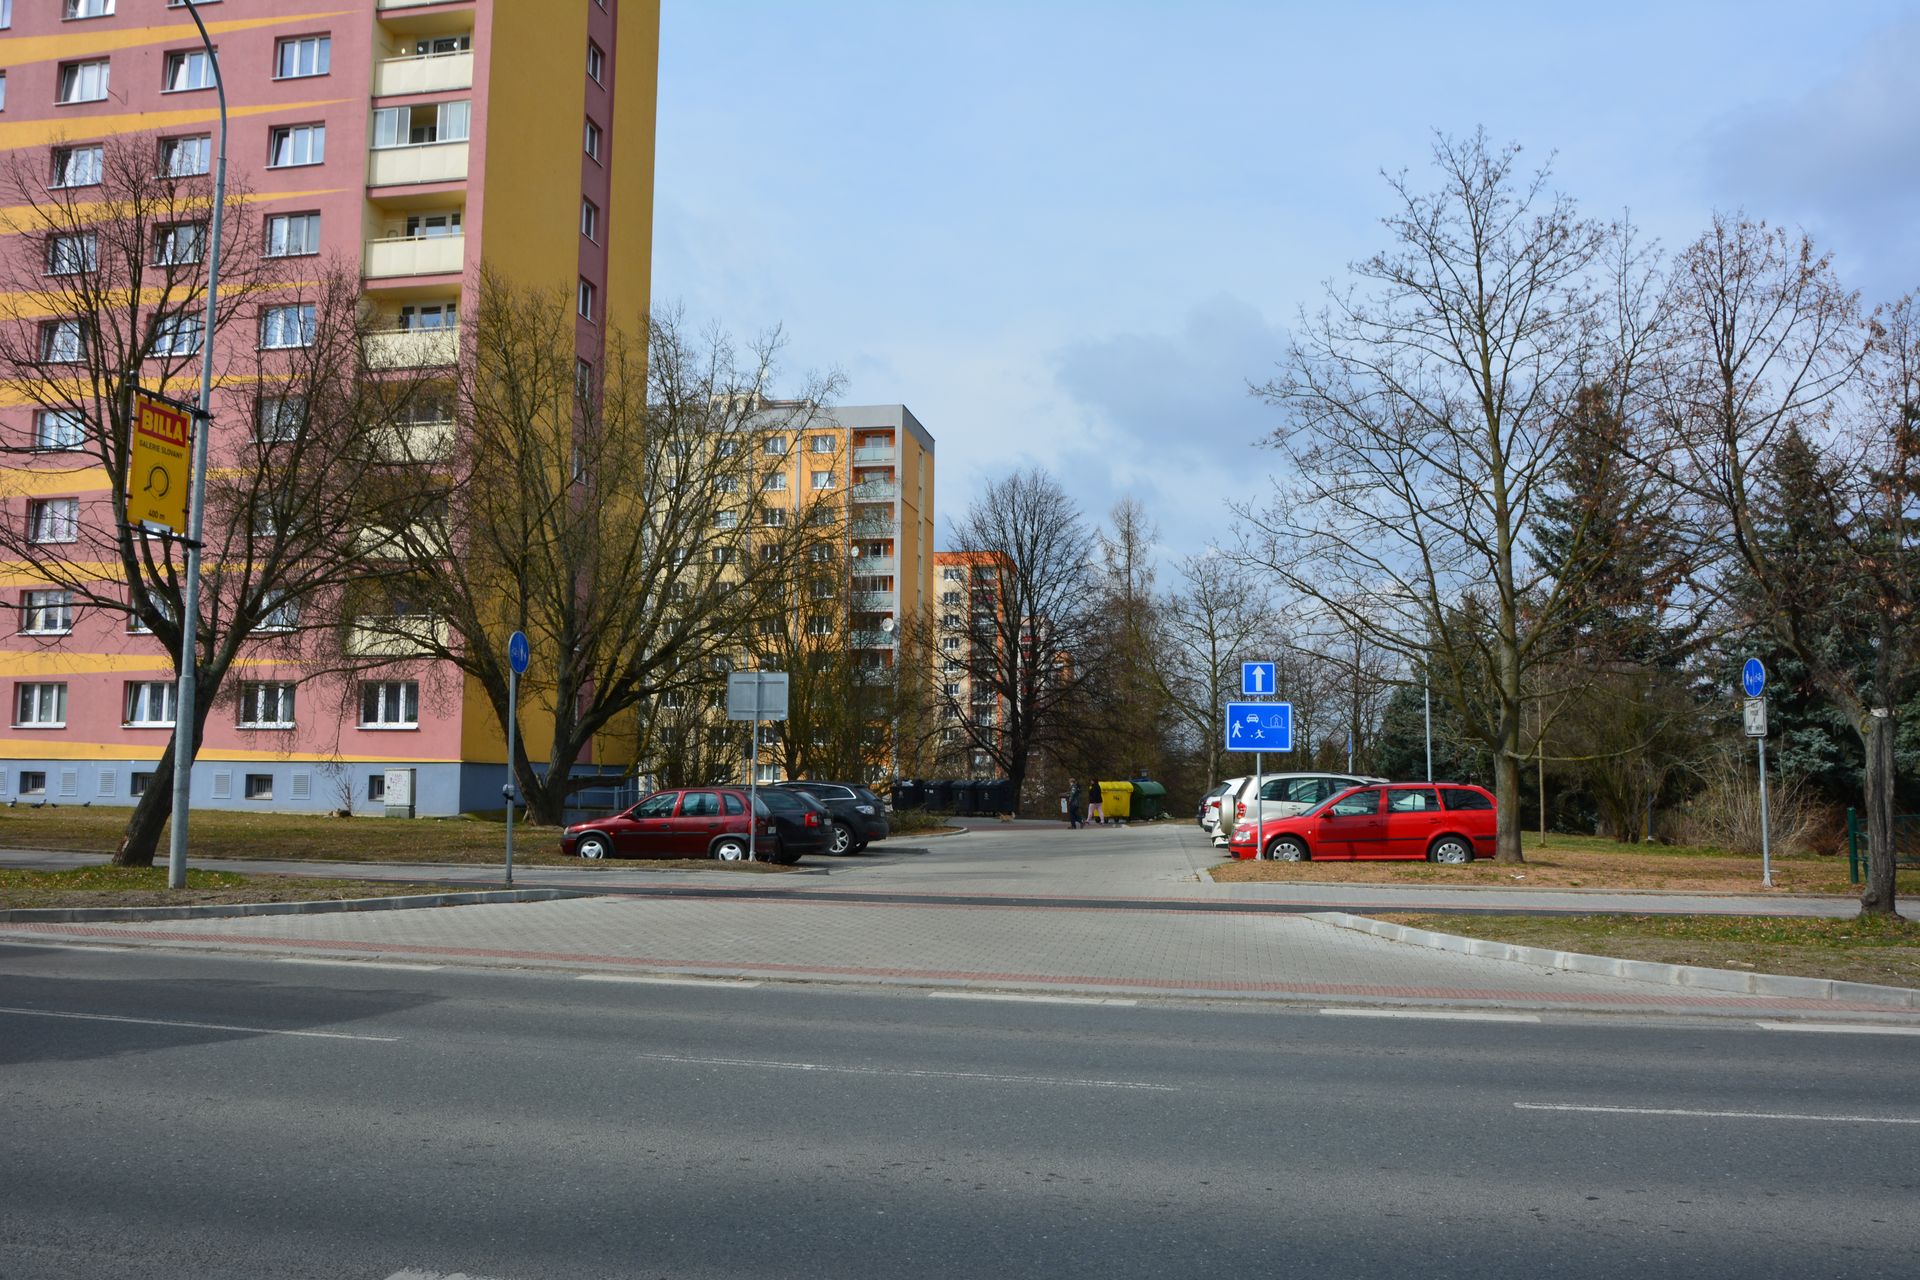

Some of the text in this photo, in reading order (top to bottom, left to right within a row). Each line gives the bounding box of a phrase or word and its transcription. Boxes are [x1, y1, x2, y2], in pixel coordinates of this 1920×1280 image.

[142, 409, 183, 442] BILLA
[139, 439, 183, 459] GALERIE SLOVANY
